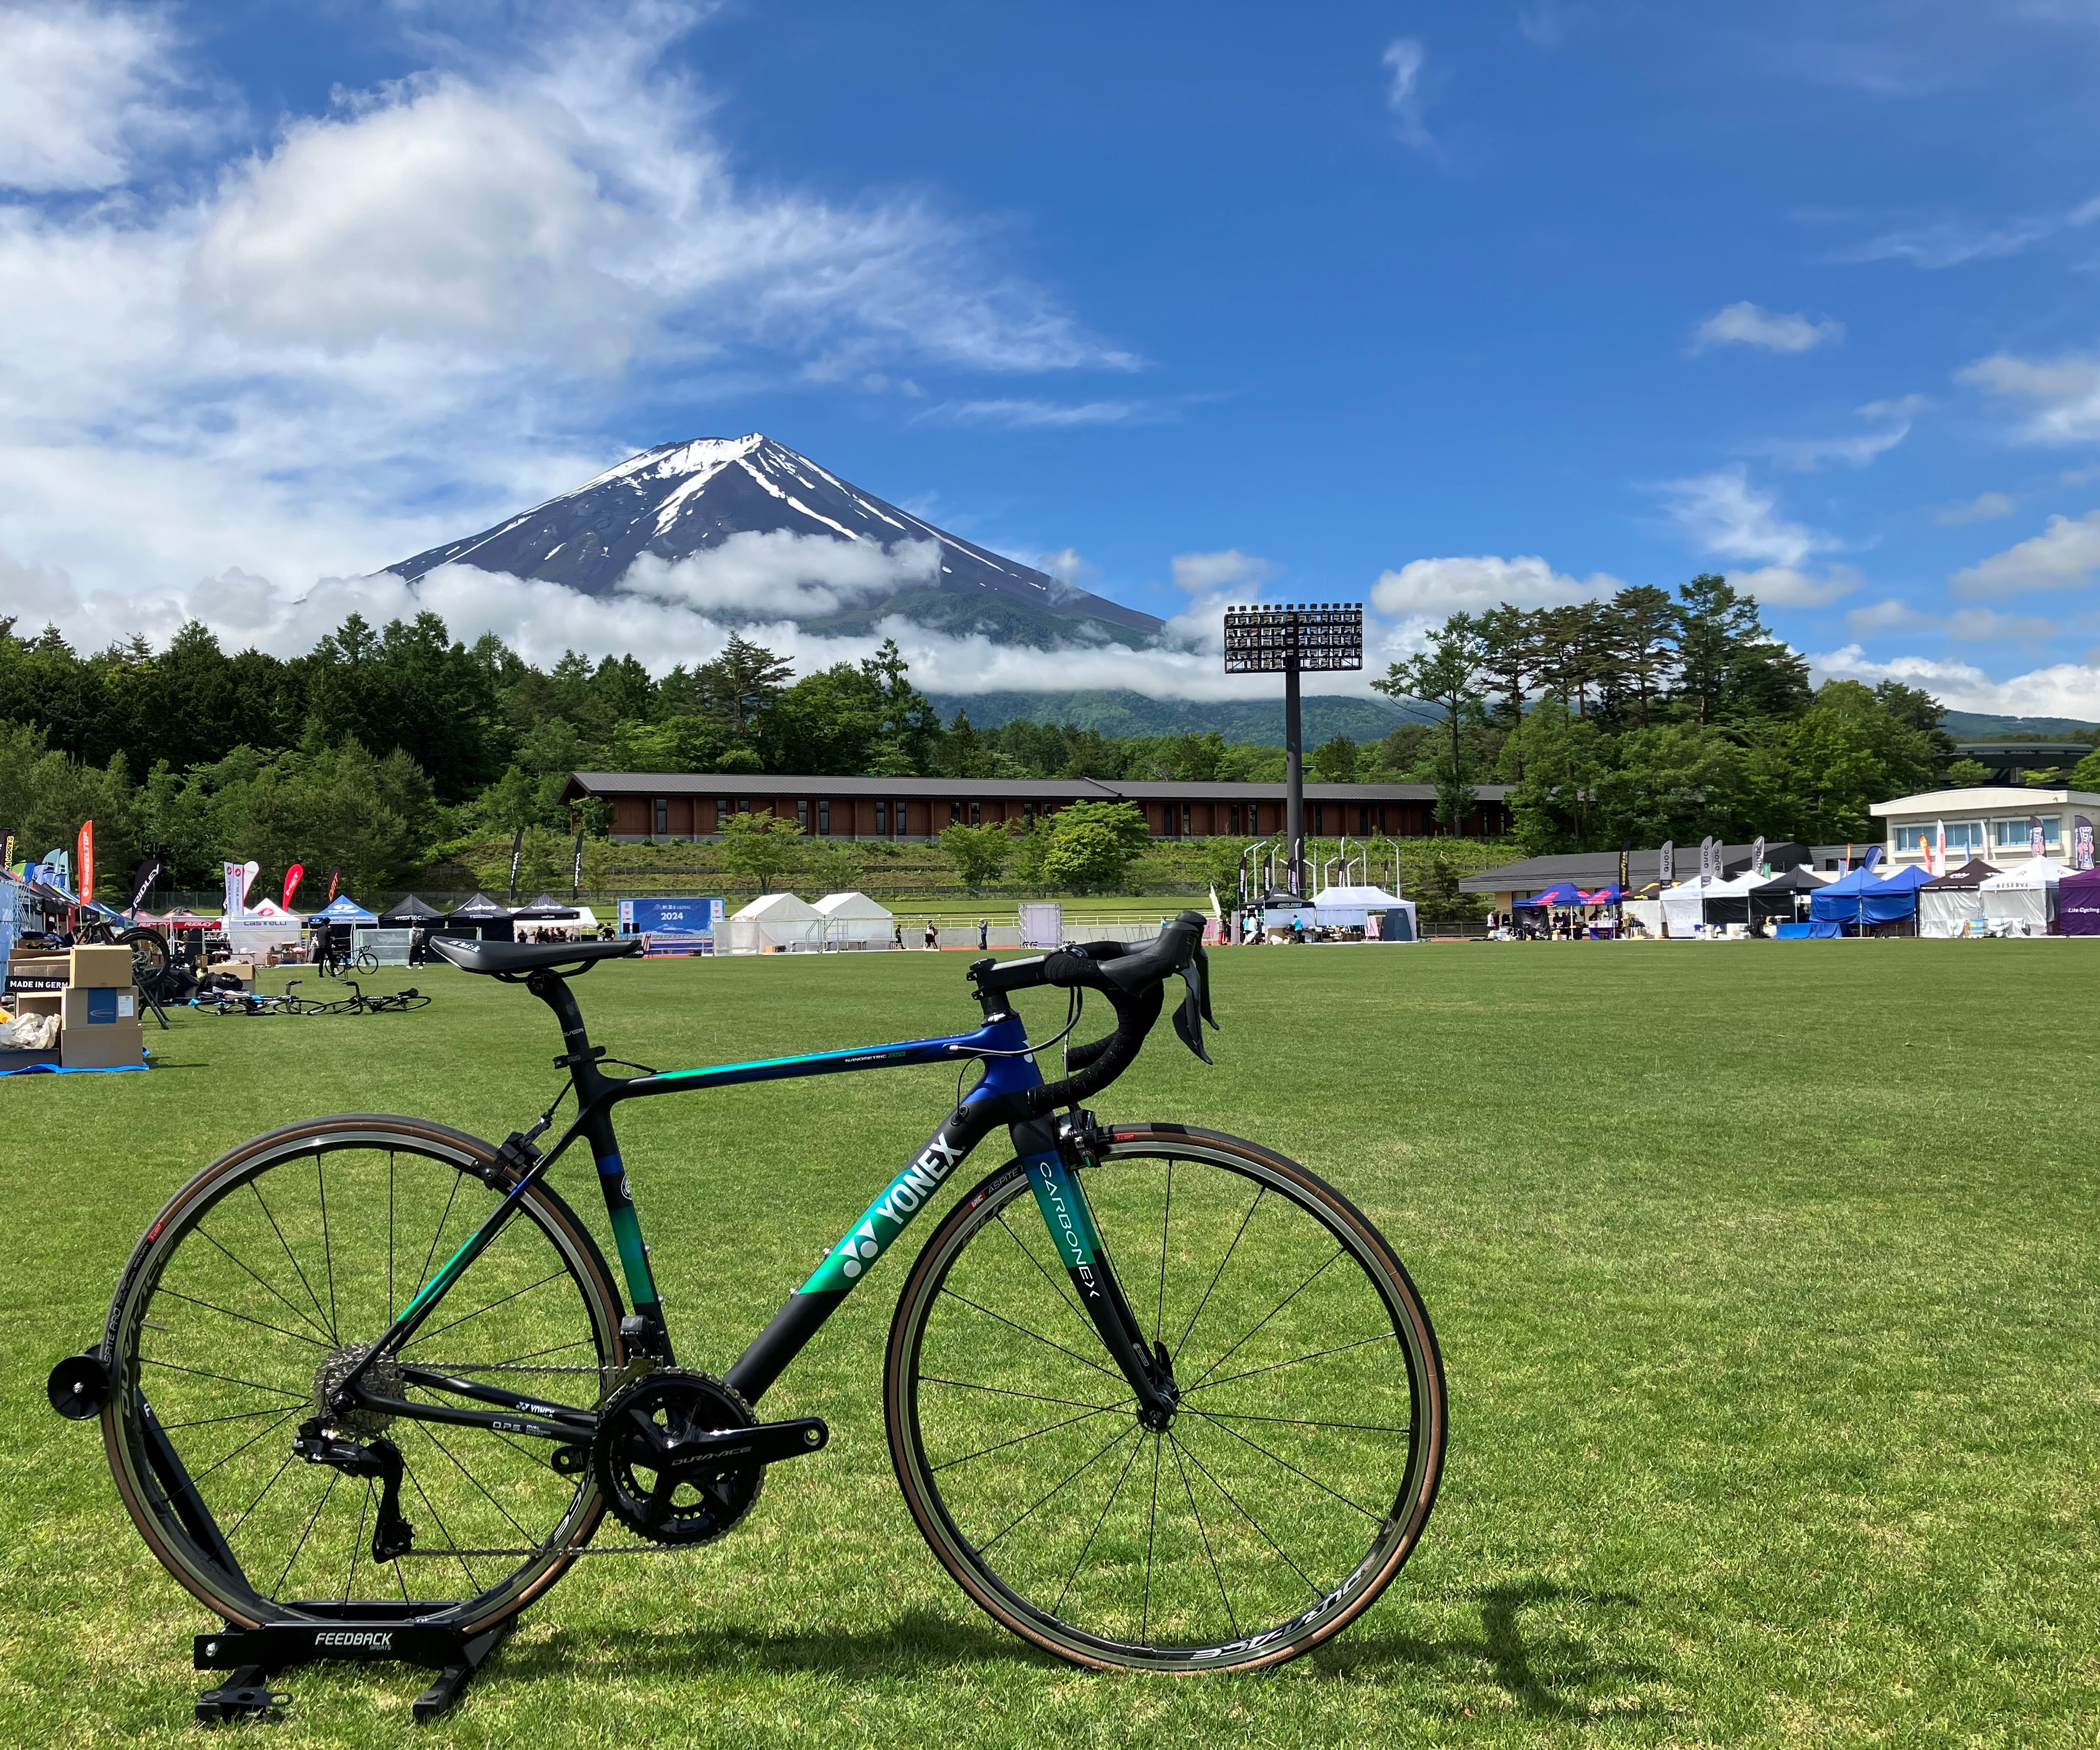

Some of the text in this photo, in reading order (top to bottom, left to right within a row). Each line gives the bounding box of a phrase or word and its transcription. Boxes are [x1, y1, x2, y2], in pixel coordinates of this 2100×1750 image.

[5, 835, 14, 861] WORKS
[133, 863, 160, 909] RIDLEY
[661, 912, 684, 921] 2024
[875, 1132, 964, 1225] YONEX
[1040, 1162, 1100, 1297] CARBONEX
[671, 1446, 752, 1467] DURA-ACE
[315, 1632, 393, 1646] FEEDBACK
